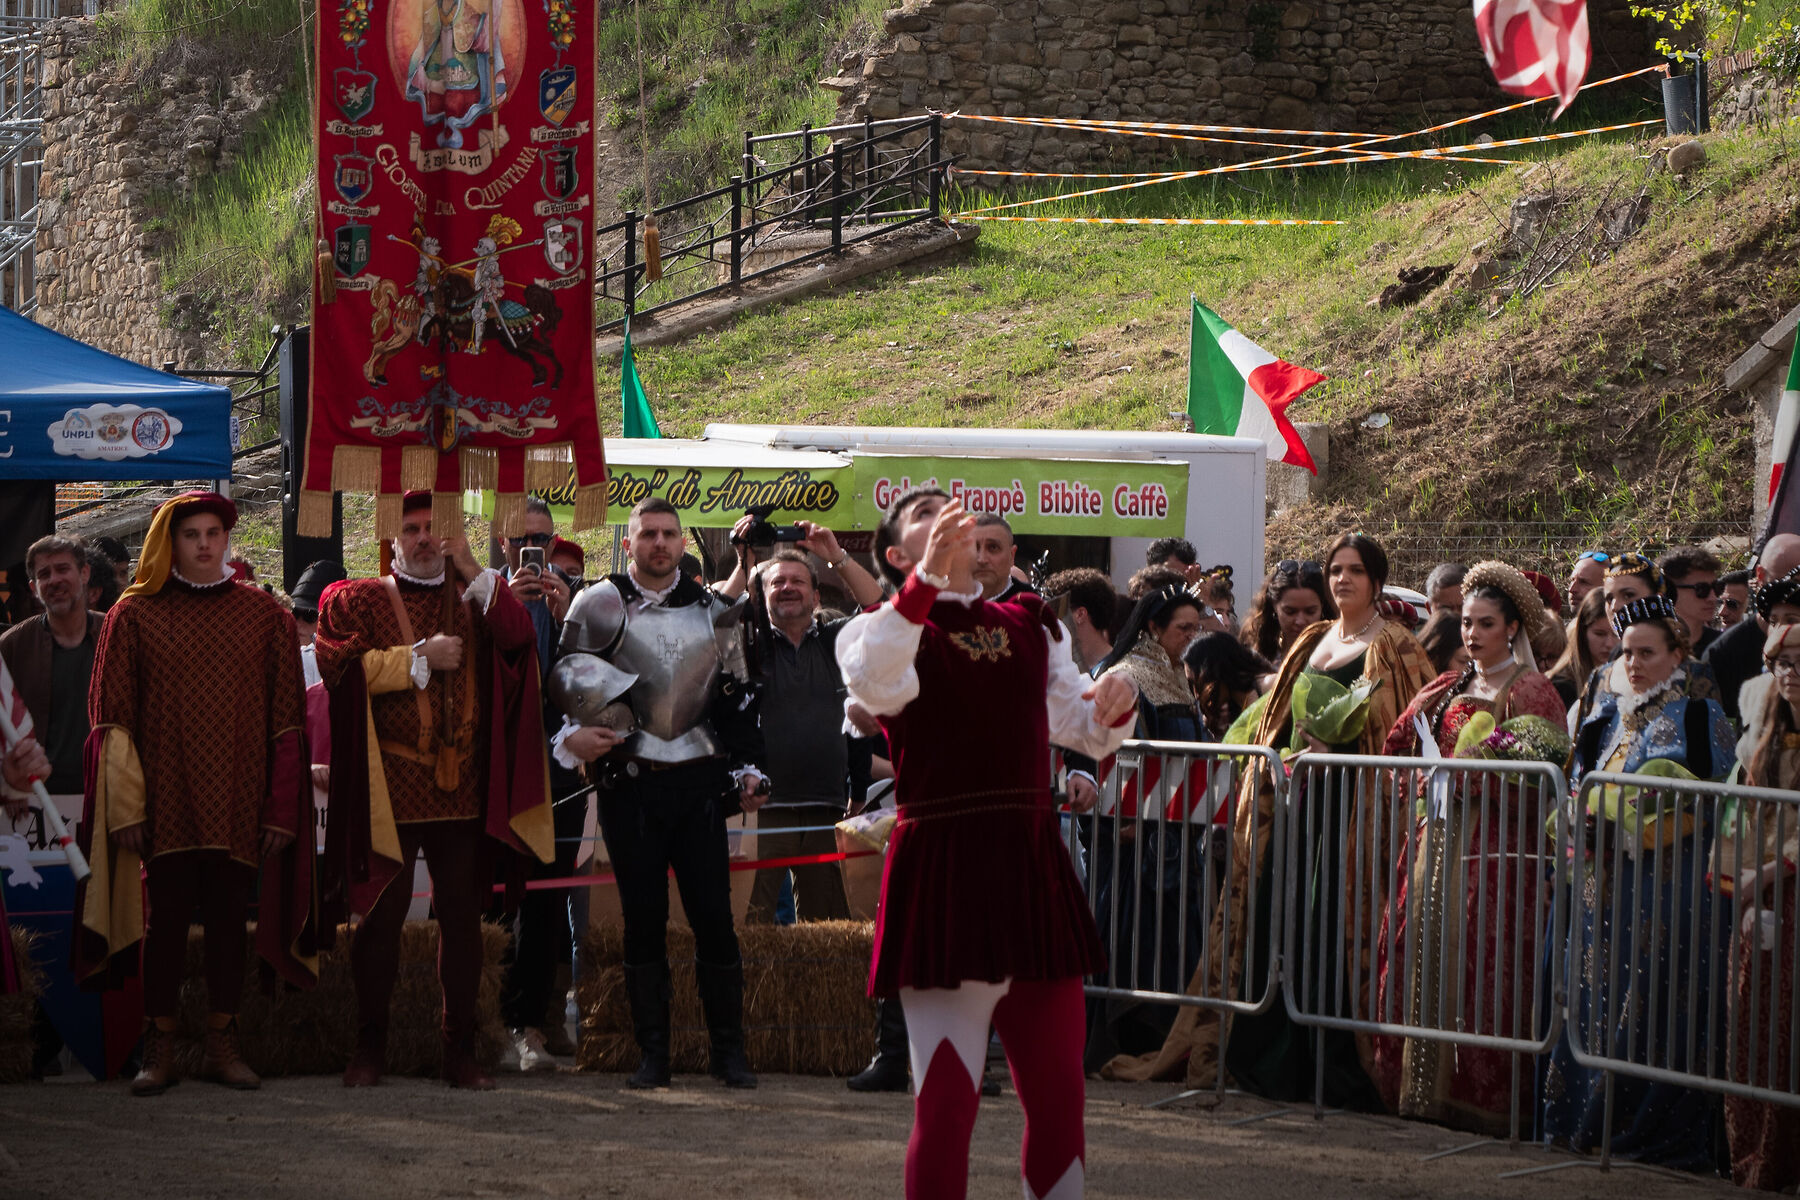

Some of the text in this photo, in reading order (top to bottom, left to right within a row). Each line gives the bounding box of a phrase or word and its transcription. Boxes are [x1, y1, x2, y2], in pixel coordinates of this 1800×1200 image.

[464, 146, 539, 210] QUINTANA
[62, 430, 94, 439] UNPLI
[667, 469, 699, 508] di
[702, 469, 838, 511] Amatrice
[952, 481, 1025, 516] Frappè
[1040, 482, 1101, 514] Bibite
[1114, 484, 1167, 517] Caffè
